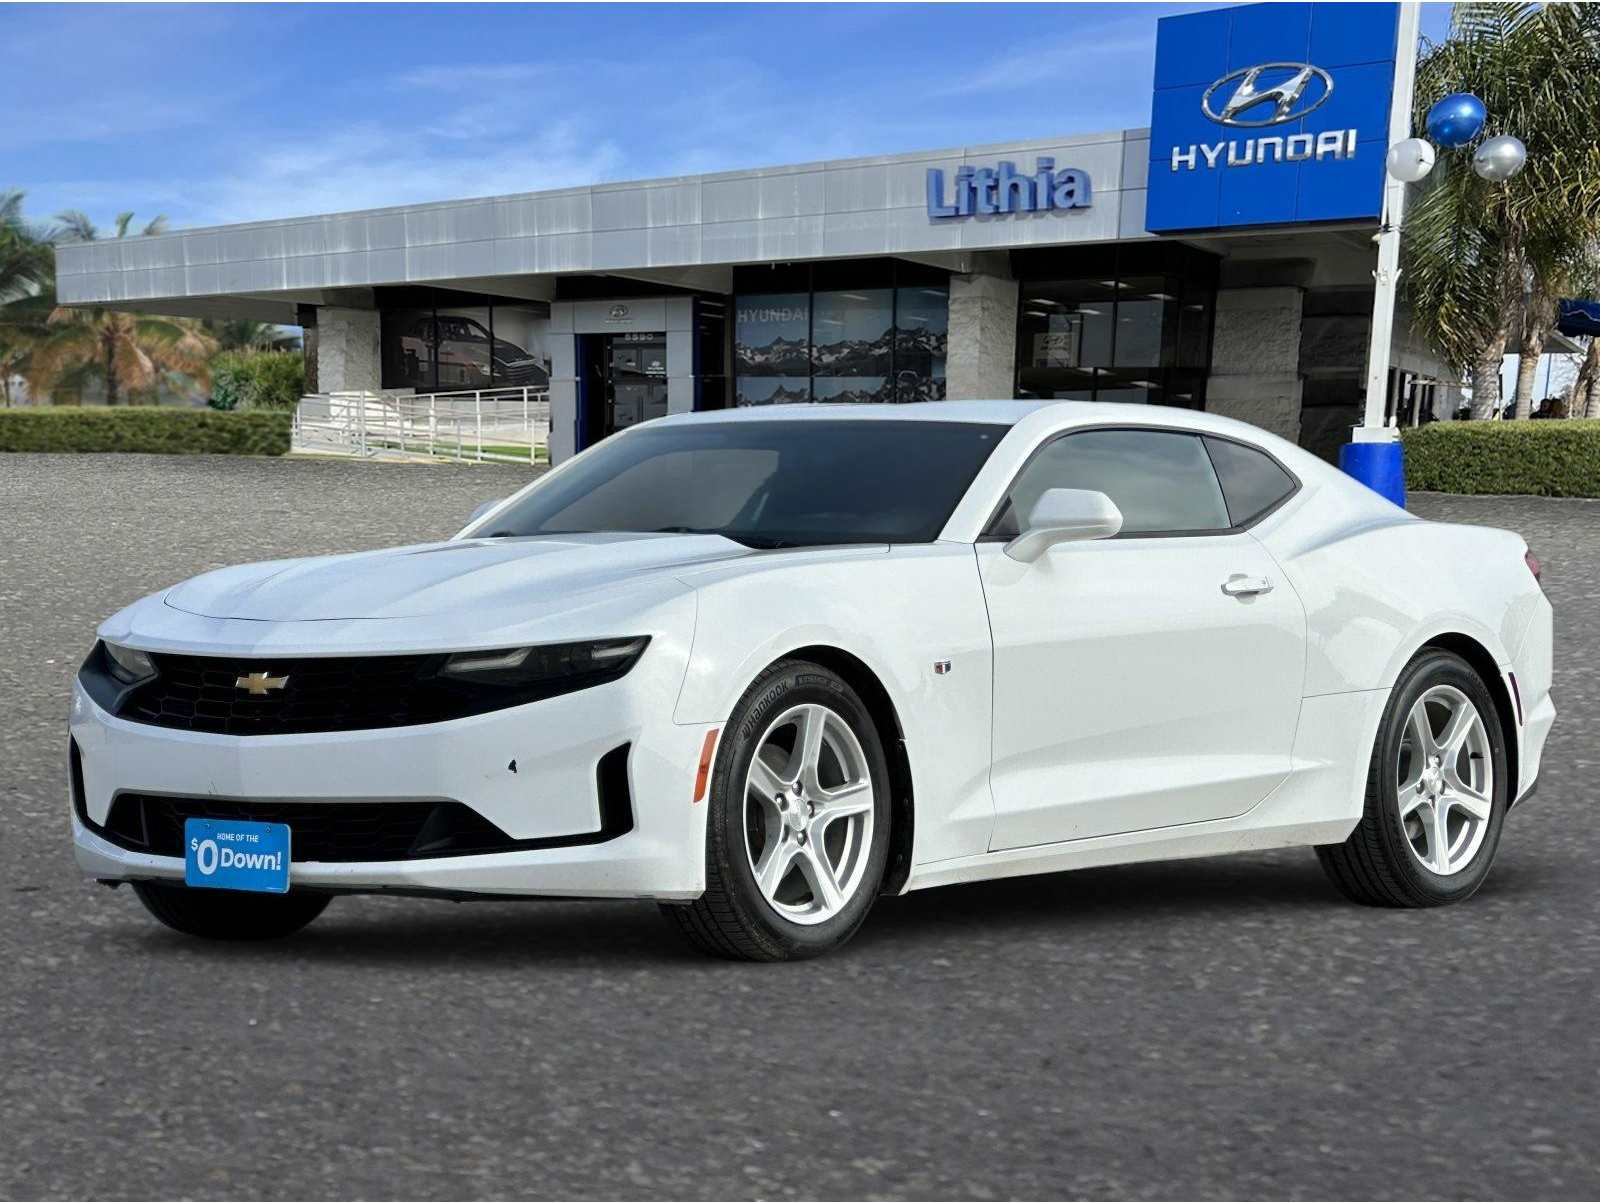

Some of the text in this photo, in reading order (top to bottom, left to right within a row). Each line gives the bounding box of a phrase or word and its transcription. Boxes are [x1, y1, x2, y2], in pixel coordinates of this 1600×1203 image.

[1170, 128, 1358, 172] HYUNDAI
[926, 155, 1092, 219] Lithia
[737, 306, 808, 323] HYUNDAI
[216, 832, 259, 843] HOME OF THE
[220, 847, 282, 871] Down!
